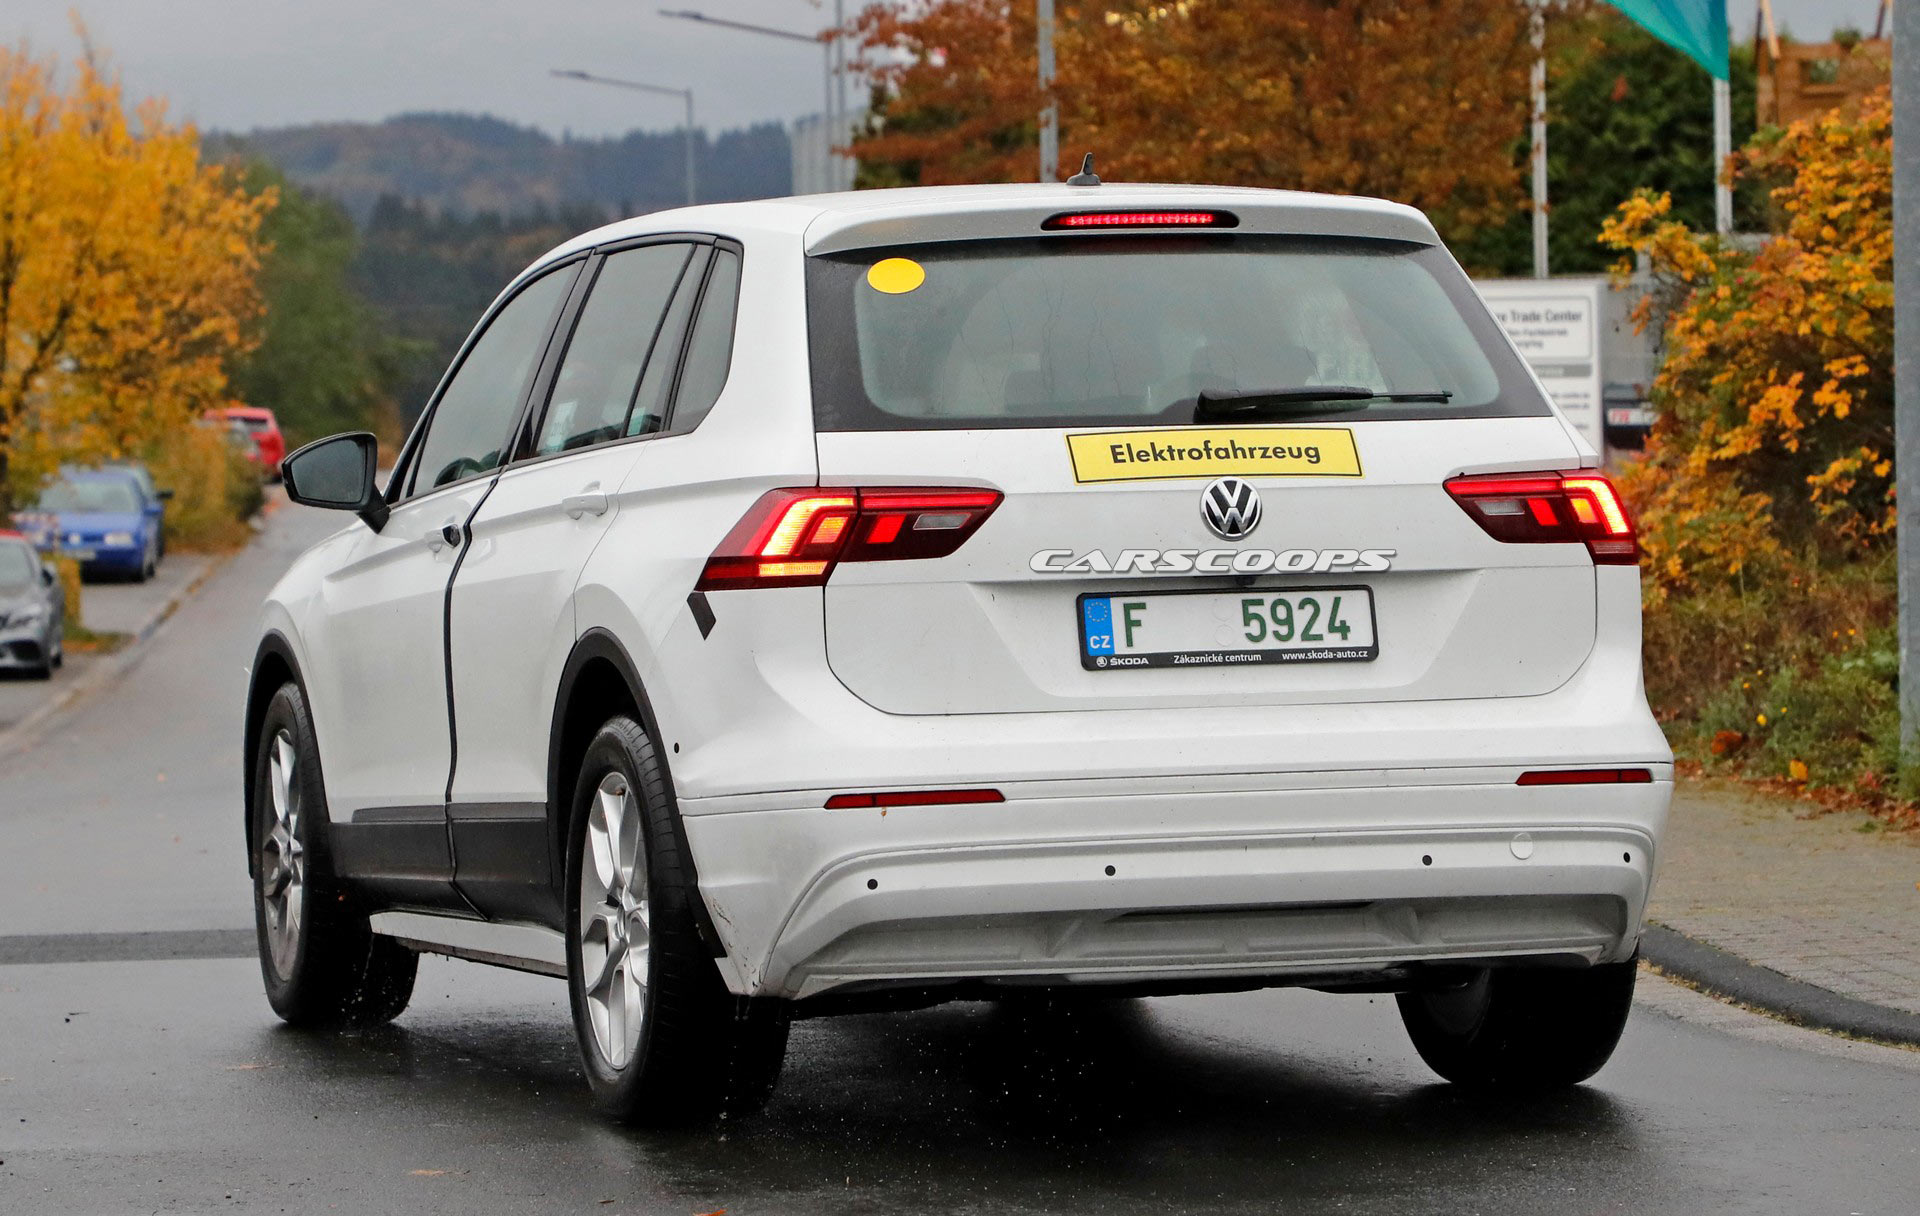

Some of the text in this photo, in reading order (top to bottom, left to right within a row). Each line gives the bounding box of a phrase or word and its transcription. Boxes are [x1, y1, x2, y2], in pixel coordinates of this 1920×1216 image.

[1511, 309, 1541, 322] Trade
[1545, 309, 1582, 322] Center
[1110, 440, 1321, 465] Elektrofahrzeug
[1123, 596, 1350, 647] F 5924
[1089, 635, 1111, 649] CZ
[1110, 649, 1368, 666] ŠKODA Zákaznické centrum www.skoda-auto.cz
